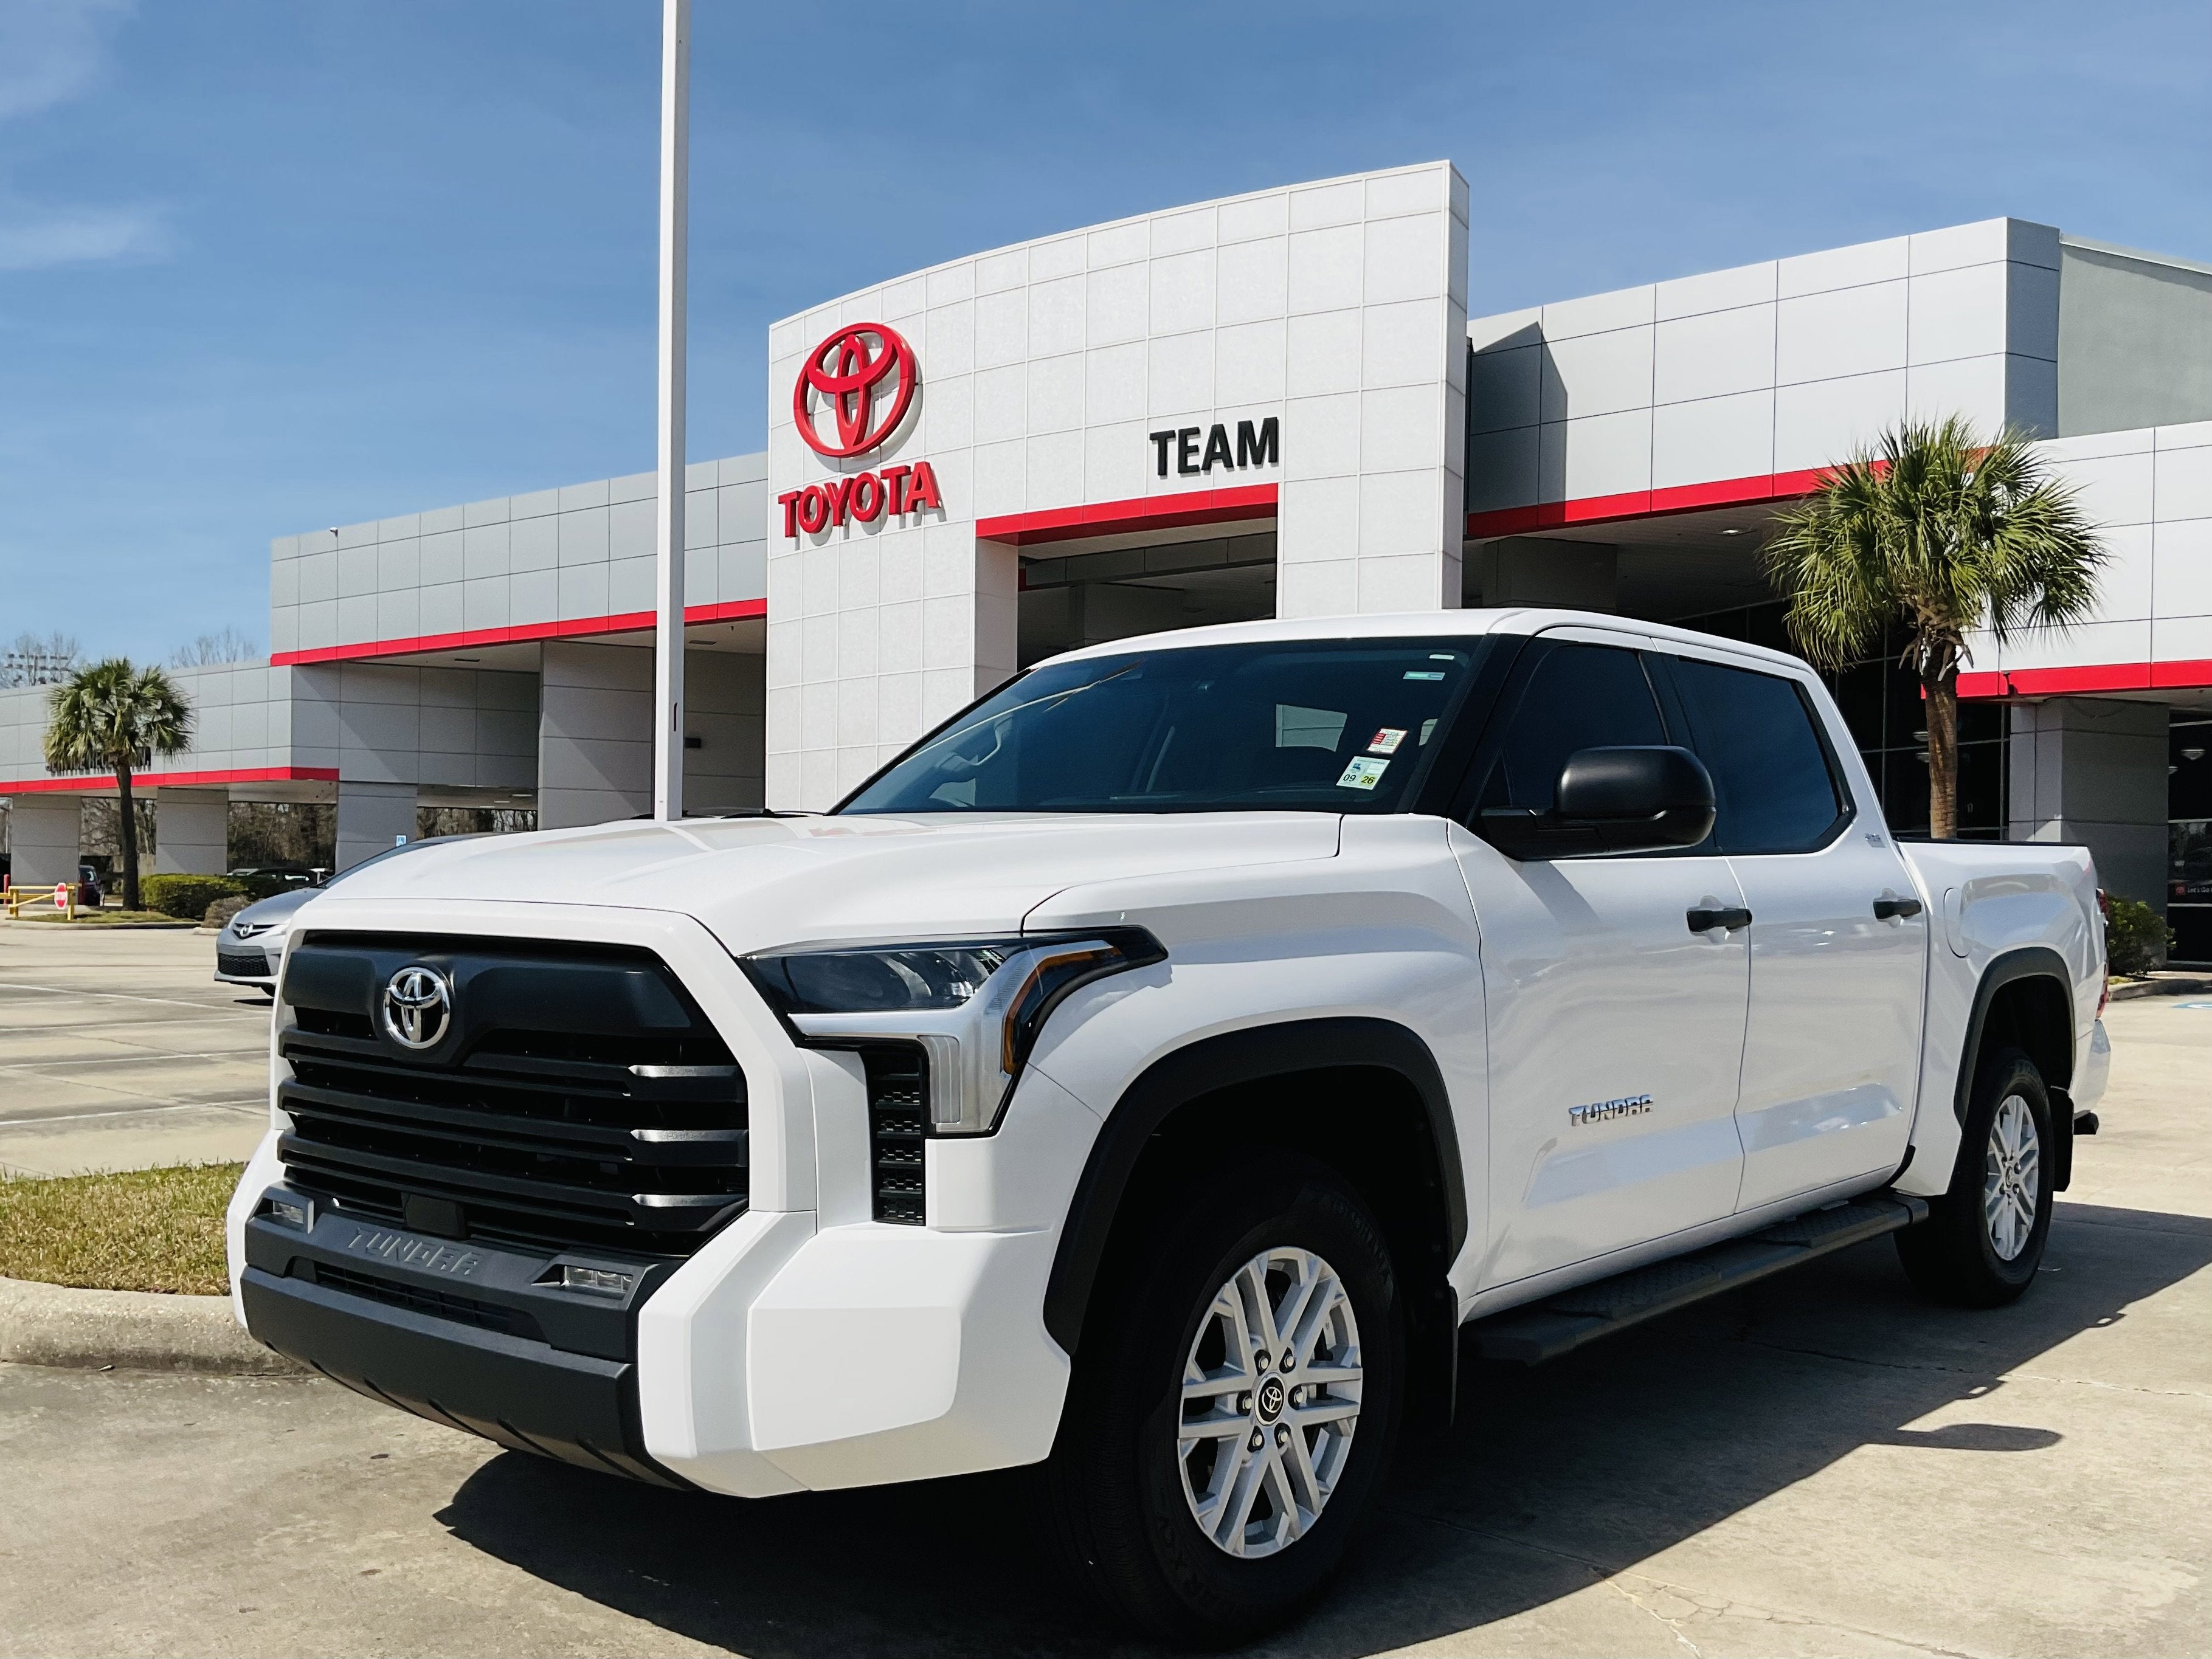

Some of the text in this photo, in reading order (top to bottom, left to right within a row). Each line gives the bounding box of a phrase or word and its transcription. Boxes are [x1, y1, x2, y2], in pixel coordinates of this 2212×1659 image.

[1149, 416, 1278, 476] TEAM
[778, 461, 940, 538] TOYOTA
[1361, 776, 1375, 784] 26
[1569, 1094, 1654, 1126] TUNDRA
[348, 1227, 483, 1276] TUNDRA
